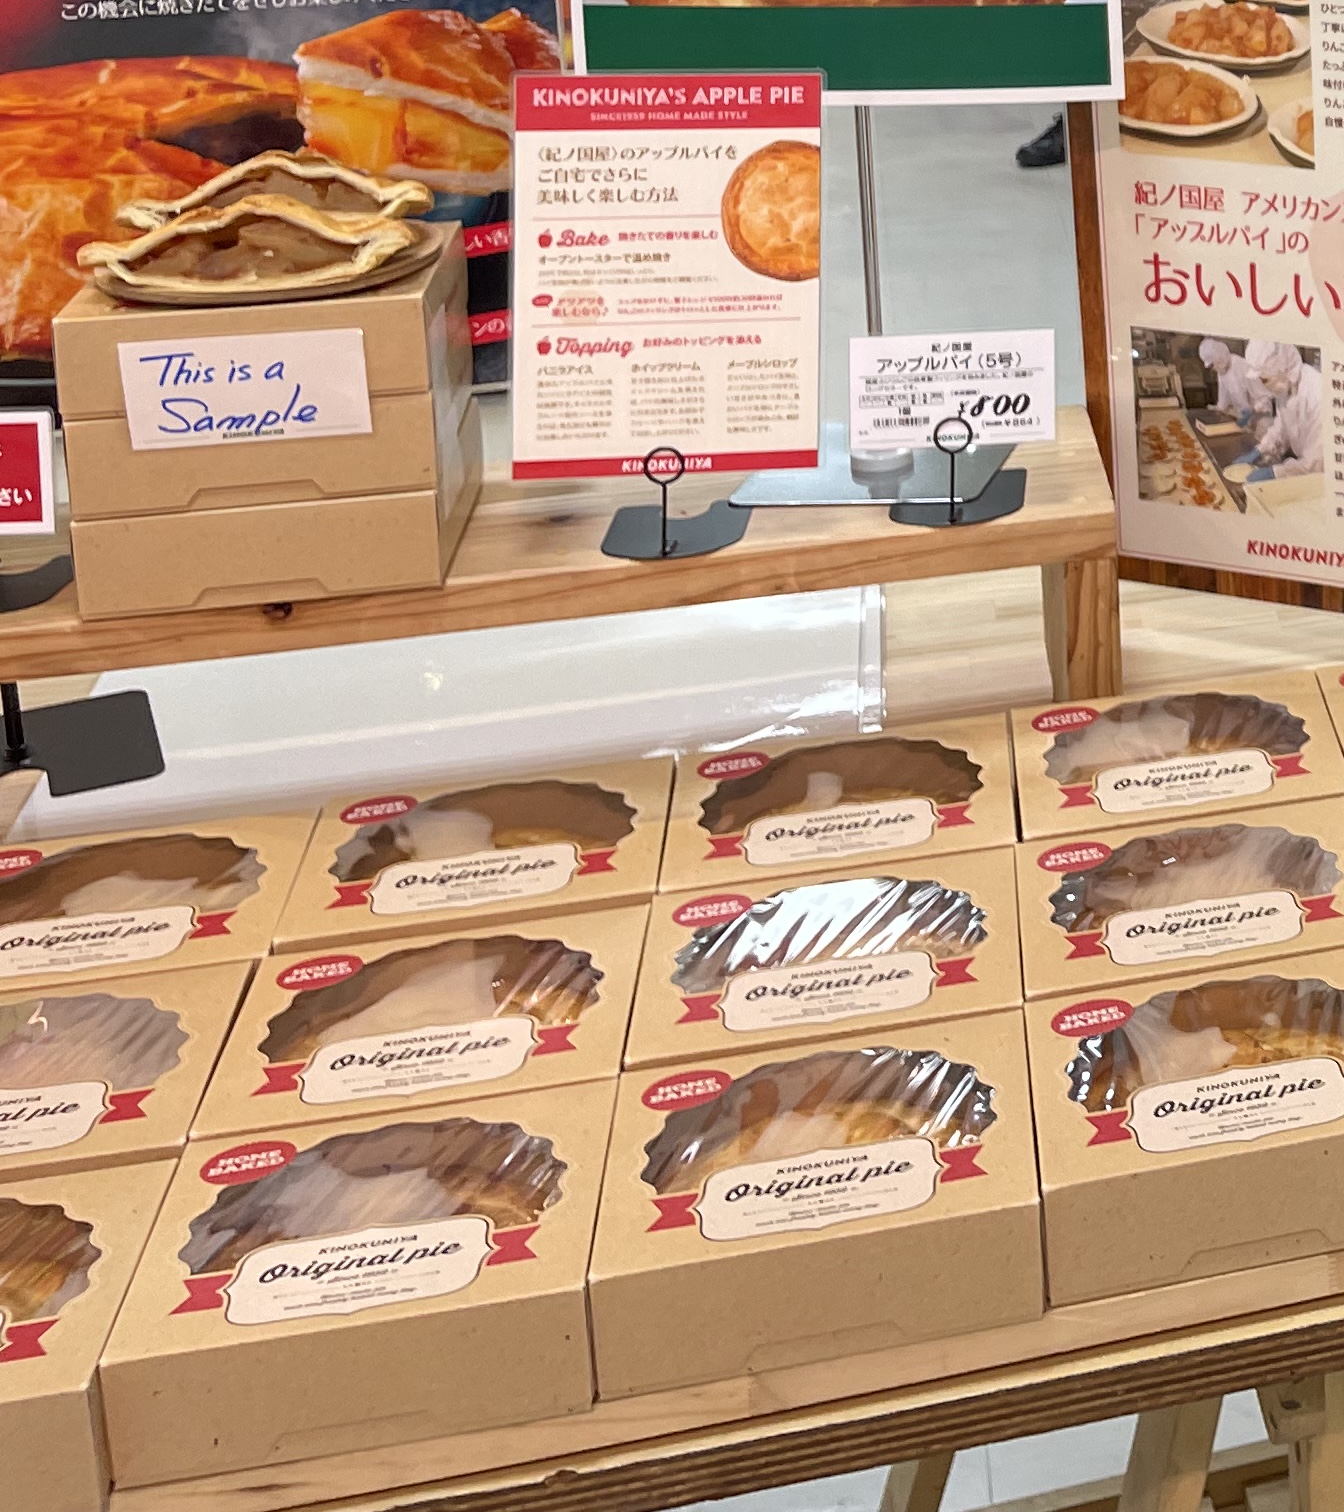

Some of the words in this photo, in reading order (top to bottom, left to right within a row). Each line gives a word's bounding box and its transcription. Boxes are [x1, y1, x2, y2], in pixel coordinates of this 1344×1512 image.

[532, 86, 687, 107] KINOKUNIYA'S
[692, 86, 763, 106] APPLE
[769, 85, 805, 104] PIE
[648, 110, 682, 121] HOME
[684, 110, 715, 121] MADE
[537, 167, 648, 184] ご自宅でさらに
[536, 186, 679, 206] 美味しく楽しむ方法
[1134, 180, 1225, 213] 紀ノ国屋
[556, 228, 611, 248] Bake
[556, 336, 633, 358] Topping
[139, 352, 214, 388] This
[227, 357, 254, 384] is
[266, 360, 285, 382] a
[157, 383, 319, 436] Sample
[1113, 768, 1211, 792] Original
[1211, 761, 1254, 782] pie
[765, 819, 873, 844] Original
[872, 810, 915, 833] pie
[395, 863, 511, 890] Original
[511, 857, 557, 880] pie
[120, 918, 171, 937] pie
[1126, 912, 1233, 940] Original
[1233, 904, 1281, 928] pie
[744, 974, 863, 1002] Original
[859, 967, 914, 990] pie
[1058, 1013, 1126, 1032] BAKED
[1064, 1005, 1120, 1022] HOME
[329, 1042, 460, 1073] Original
[457, 1035, 513, 1060] pie
[649, 1083, 723, 1104] BAKED
[657, 1077, 717, 1094] HOME
[1195, 1072, 1281, 1094] KINOKUNIYA
[1153, 1083, 1274, 1119] Original
[1269, 1076, 1326, 1101] pie
[25, 1100, 81, 1123] pie
[207, 1158, 286, 1179] BAKED
[217, 1149, 283, 1171] HOME
[723, 1167, 858, 1202] Original
[860, 1158, 914, 1183] pie
[257, 1249, 403, 1285] Original
[402, 1238, 462, 1267] pie
